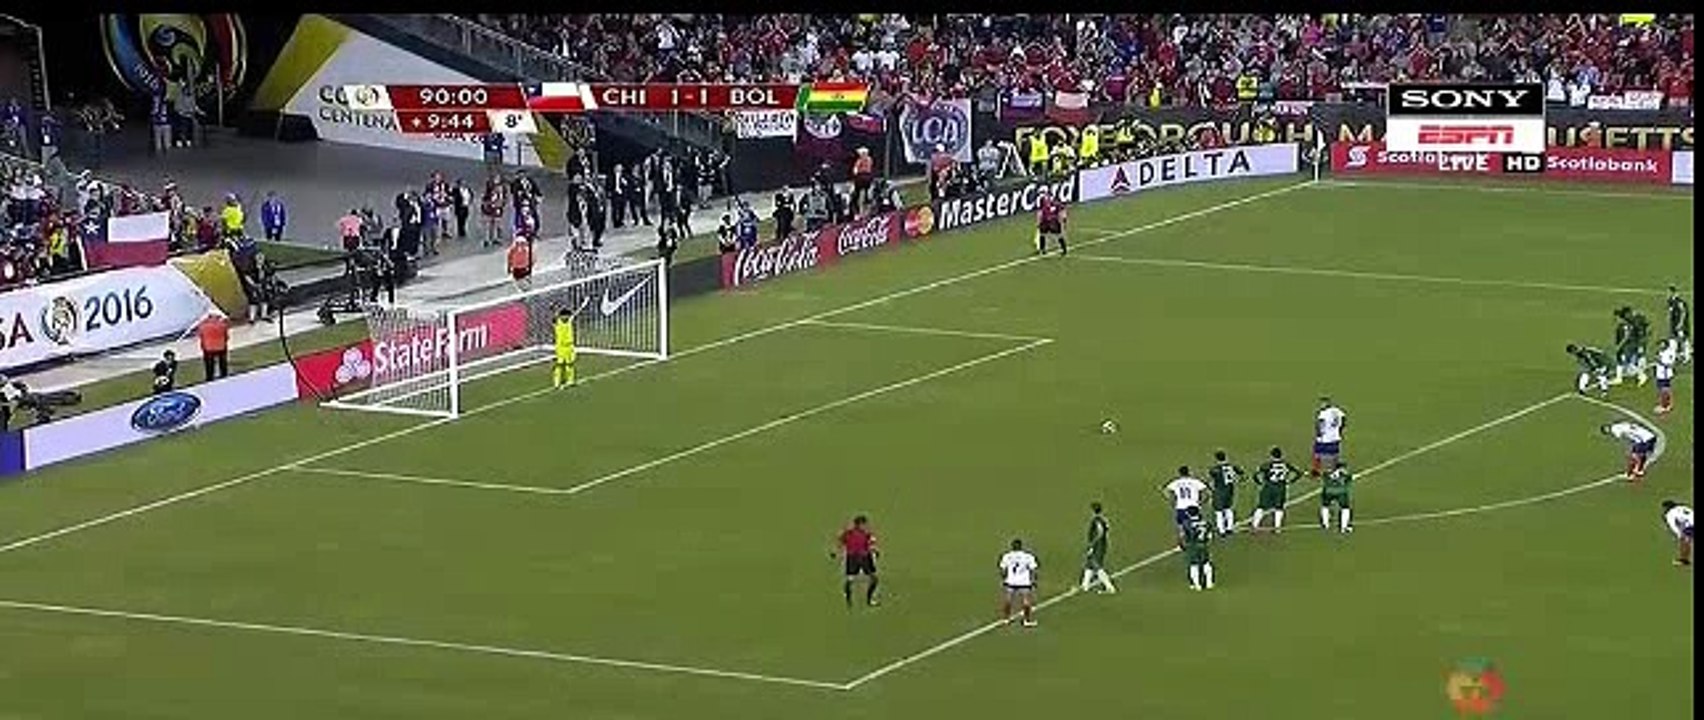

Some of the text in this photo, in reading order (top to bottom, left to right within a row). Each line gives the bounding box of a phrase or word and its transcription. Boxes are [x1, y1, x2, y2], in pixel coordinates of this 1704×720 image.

[1138, 150, 1251, 187] DELTA
[1546, 156, 1659, 173] Scotiabank
[938, 175, 1075, 231] MasterCard
[838, 214, 891, 256] Coca-Cola
[733, 229, 821, 286] Coca-Cola
[83, 285, 154, 332] 2016
